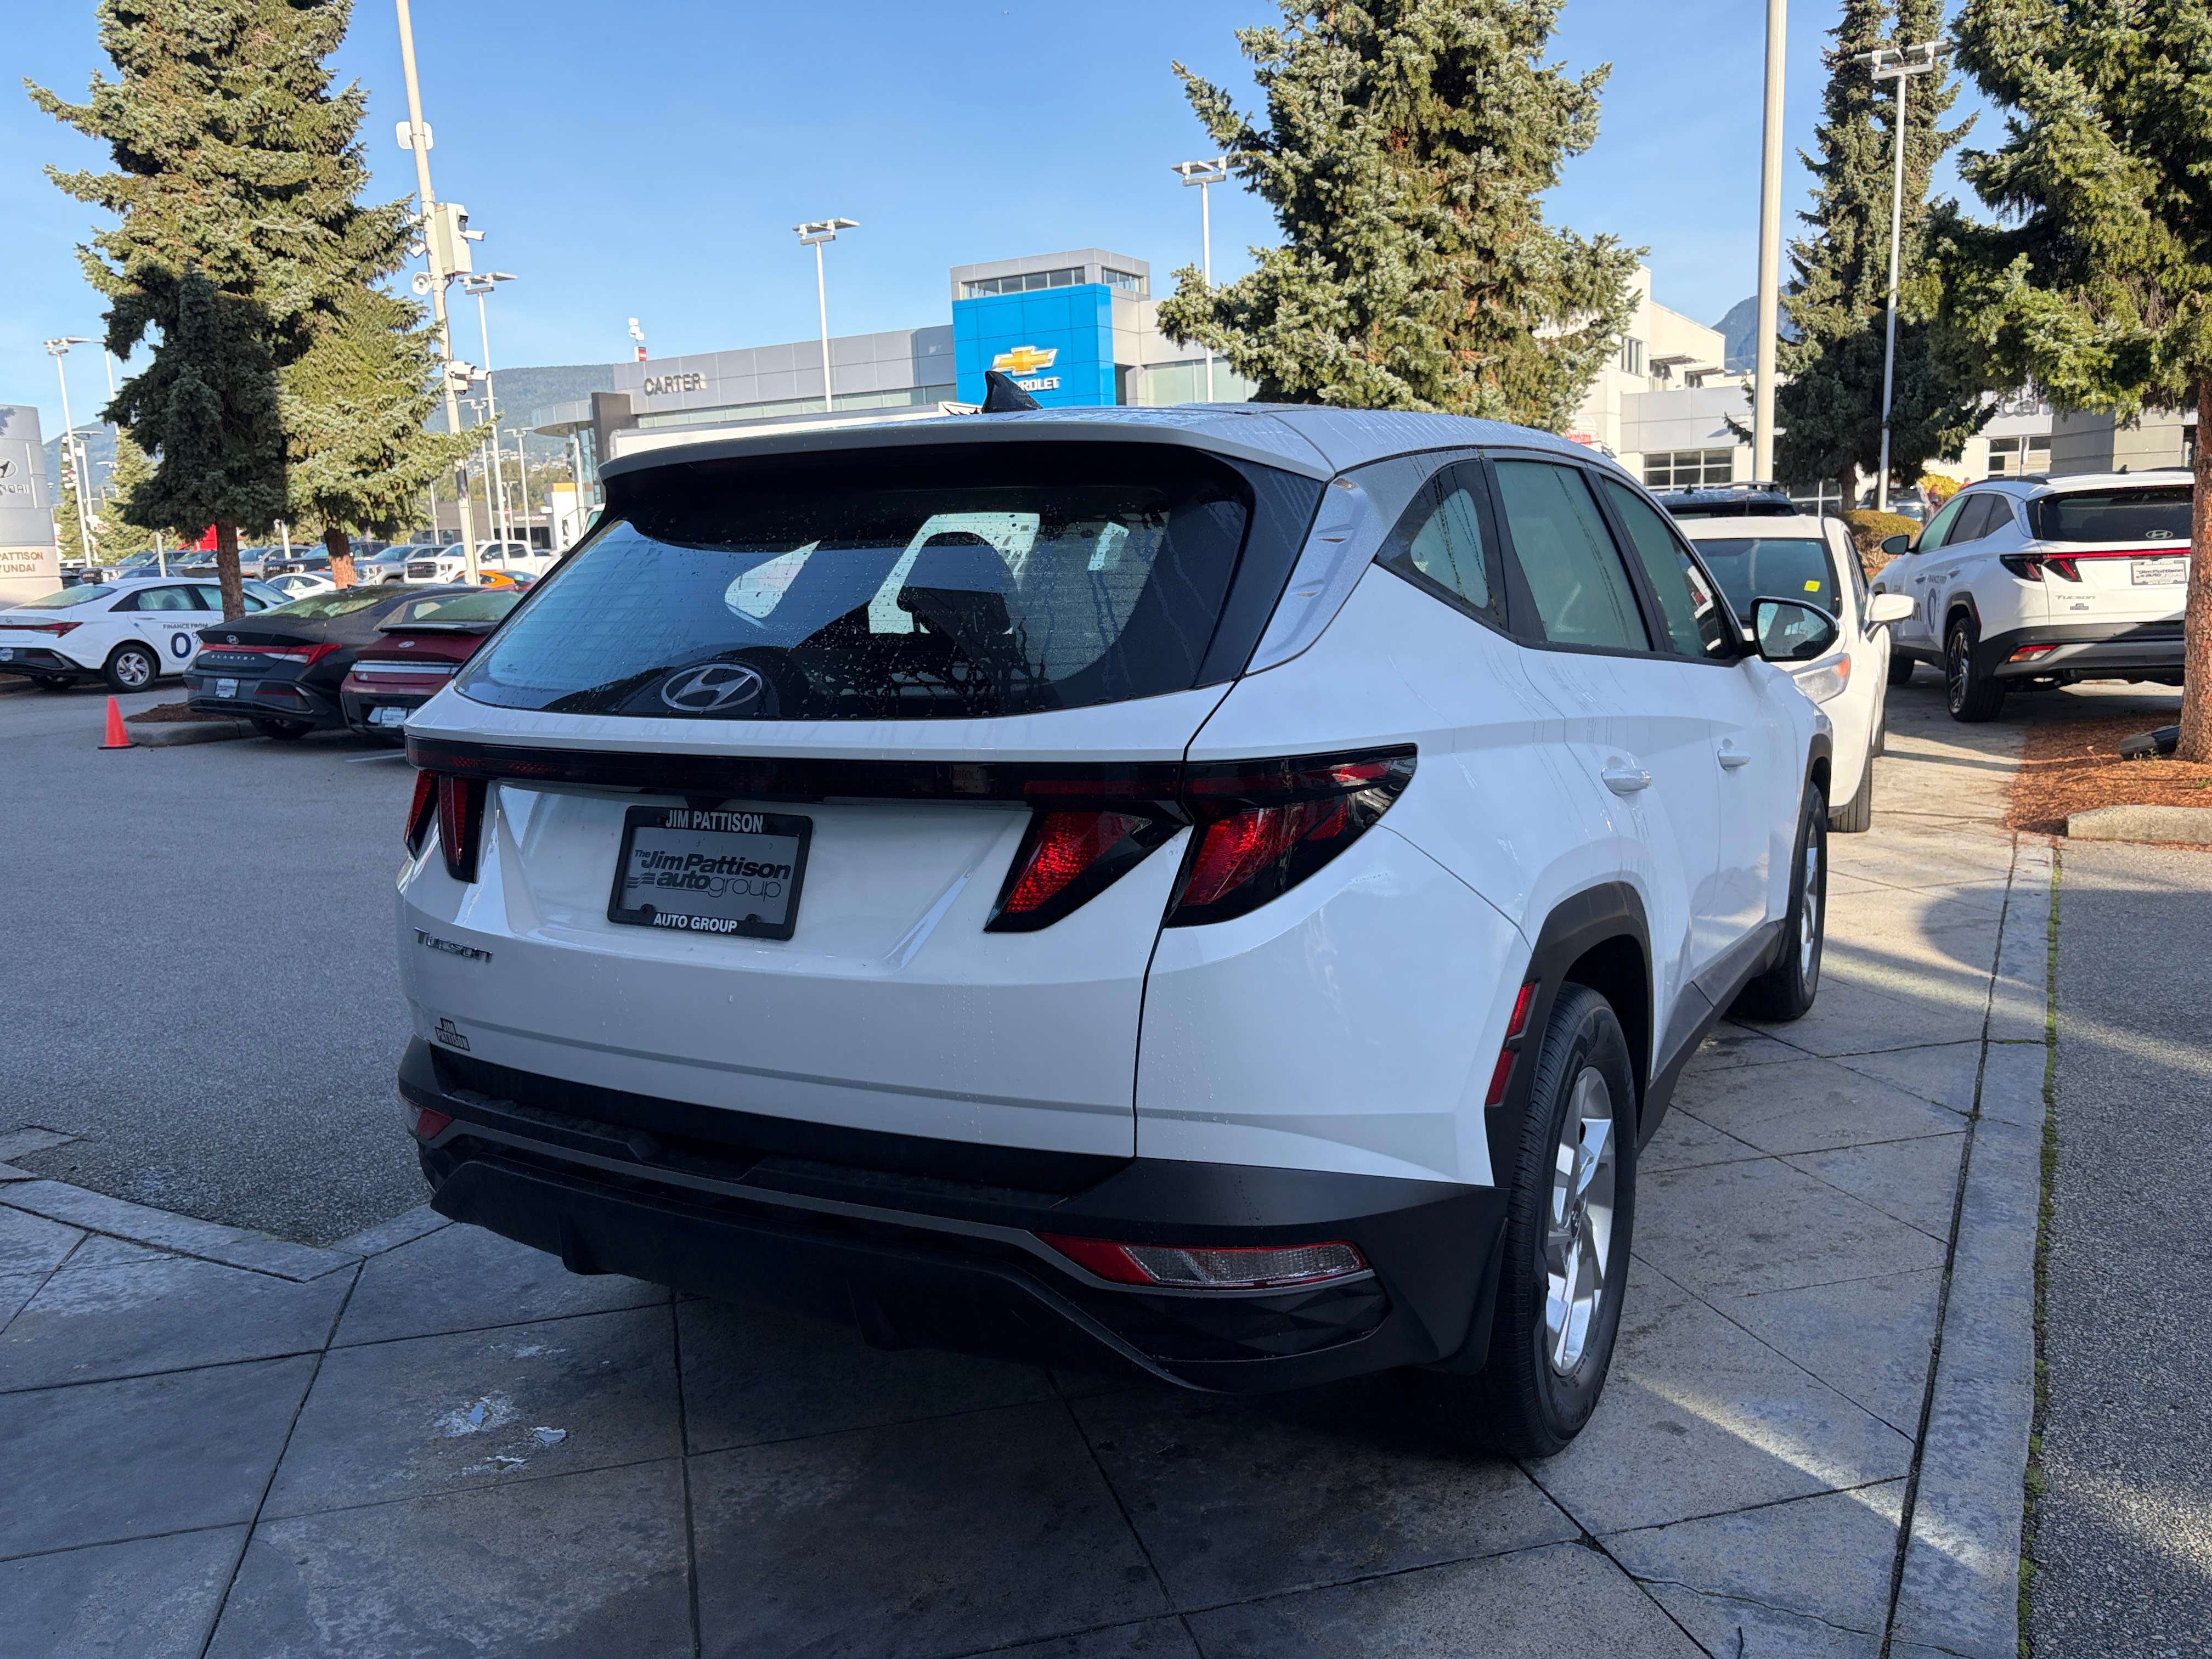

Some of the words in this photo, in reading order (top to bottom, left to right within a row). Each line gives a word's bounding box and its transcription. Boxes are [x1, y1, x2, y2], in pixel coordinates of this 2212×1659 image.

[644, 373, 702, 396] CARTER
[0, 552, 43, 561] ATTISON
[665, 809, 689, 828] JIM
[692, 811, 764, 833] PATTISON
[635, 849, 651, 858] The
[653, 913, 688, 928] AUTO
[691, 916, 737, 933] GROUP
[442, 1020, 456, 1035] JIM
[436, 1028, 470, 1050] PATTISON
